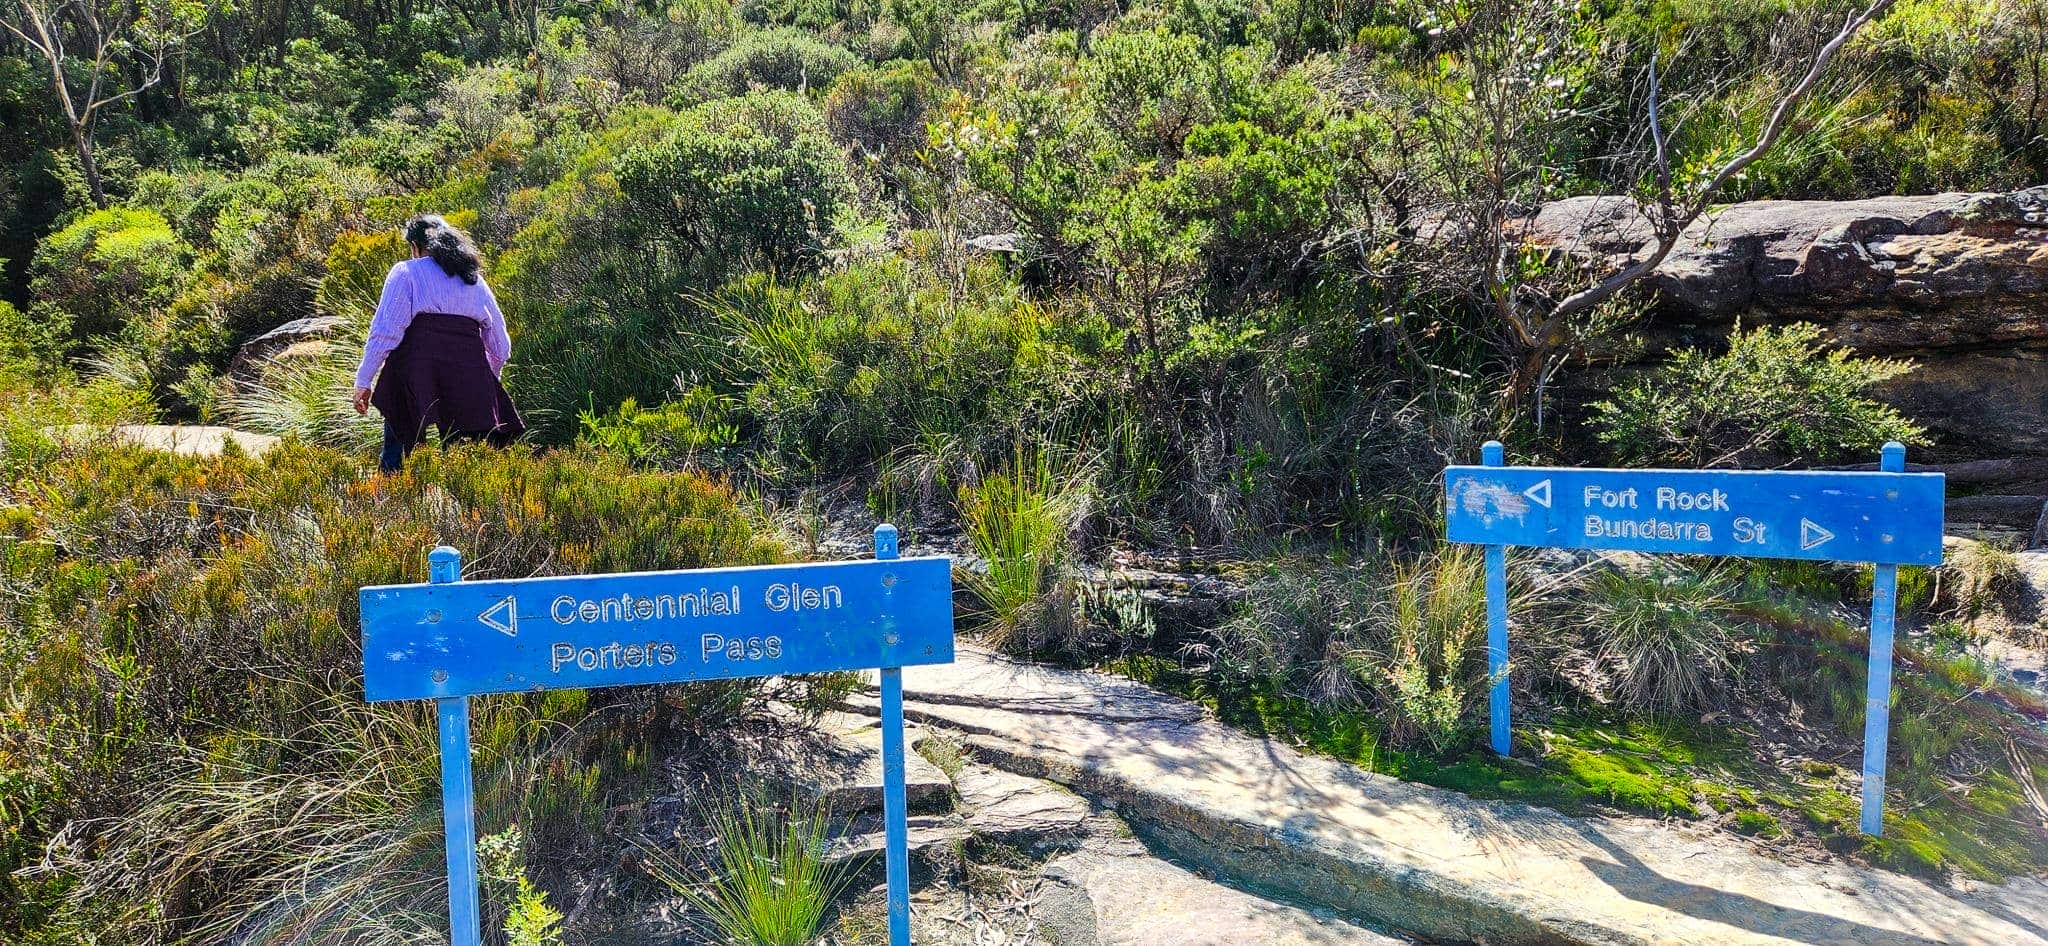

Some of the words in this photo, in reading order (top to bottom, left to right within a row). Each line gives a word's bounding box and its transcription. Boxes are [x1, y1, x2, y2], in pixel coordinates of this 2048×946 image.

[1584, 486, 1638, 509] Fort
[1656, 487, 1729, 511] Rock
[1584, 515, 1712, 541] Bundarra
[1732, 517, 1767, 545] St
[549, 584, 741, 625] Centennial
[763, 581, 843, 611] Glen
[551, 639, 677, 673] Porters
[700, 632, 783, 663] Pass
